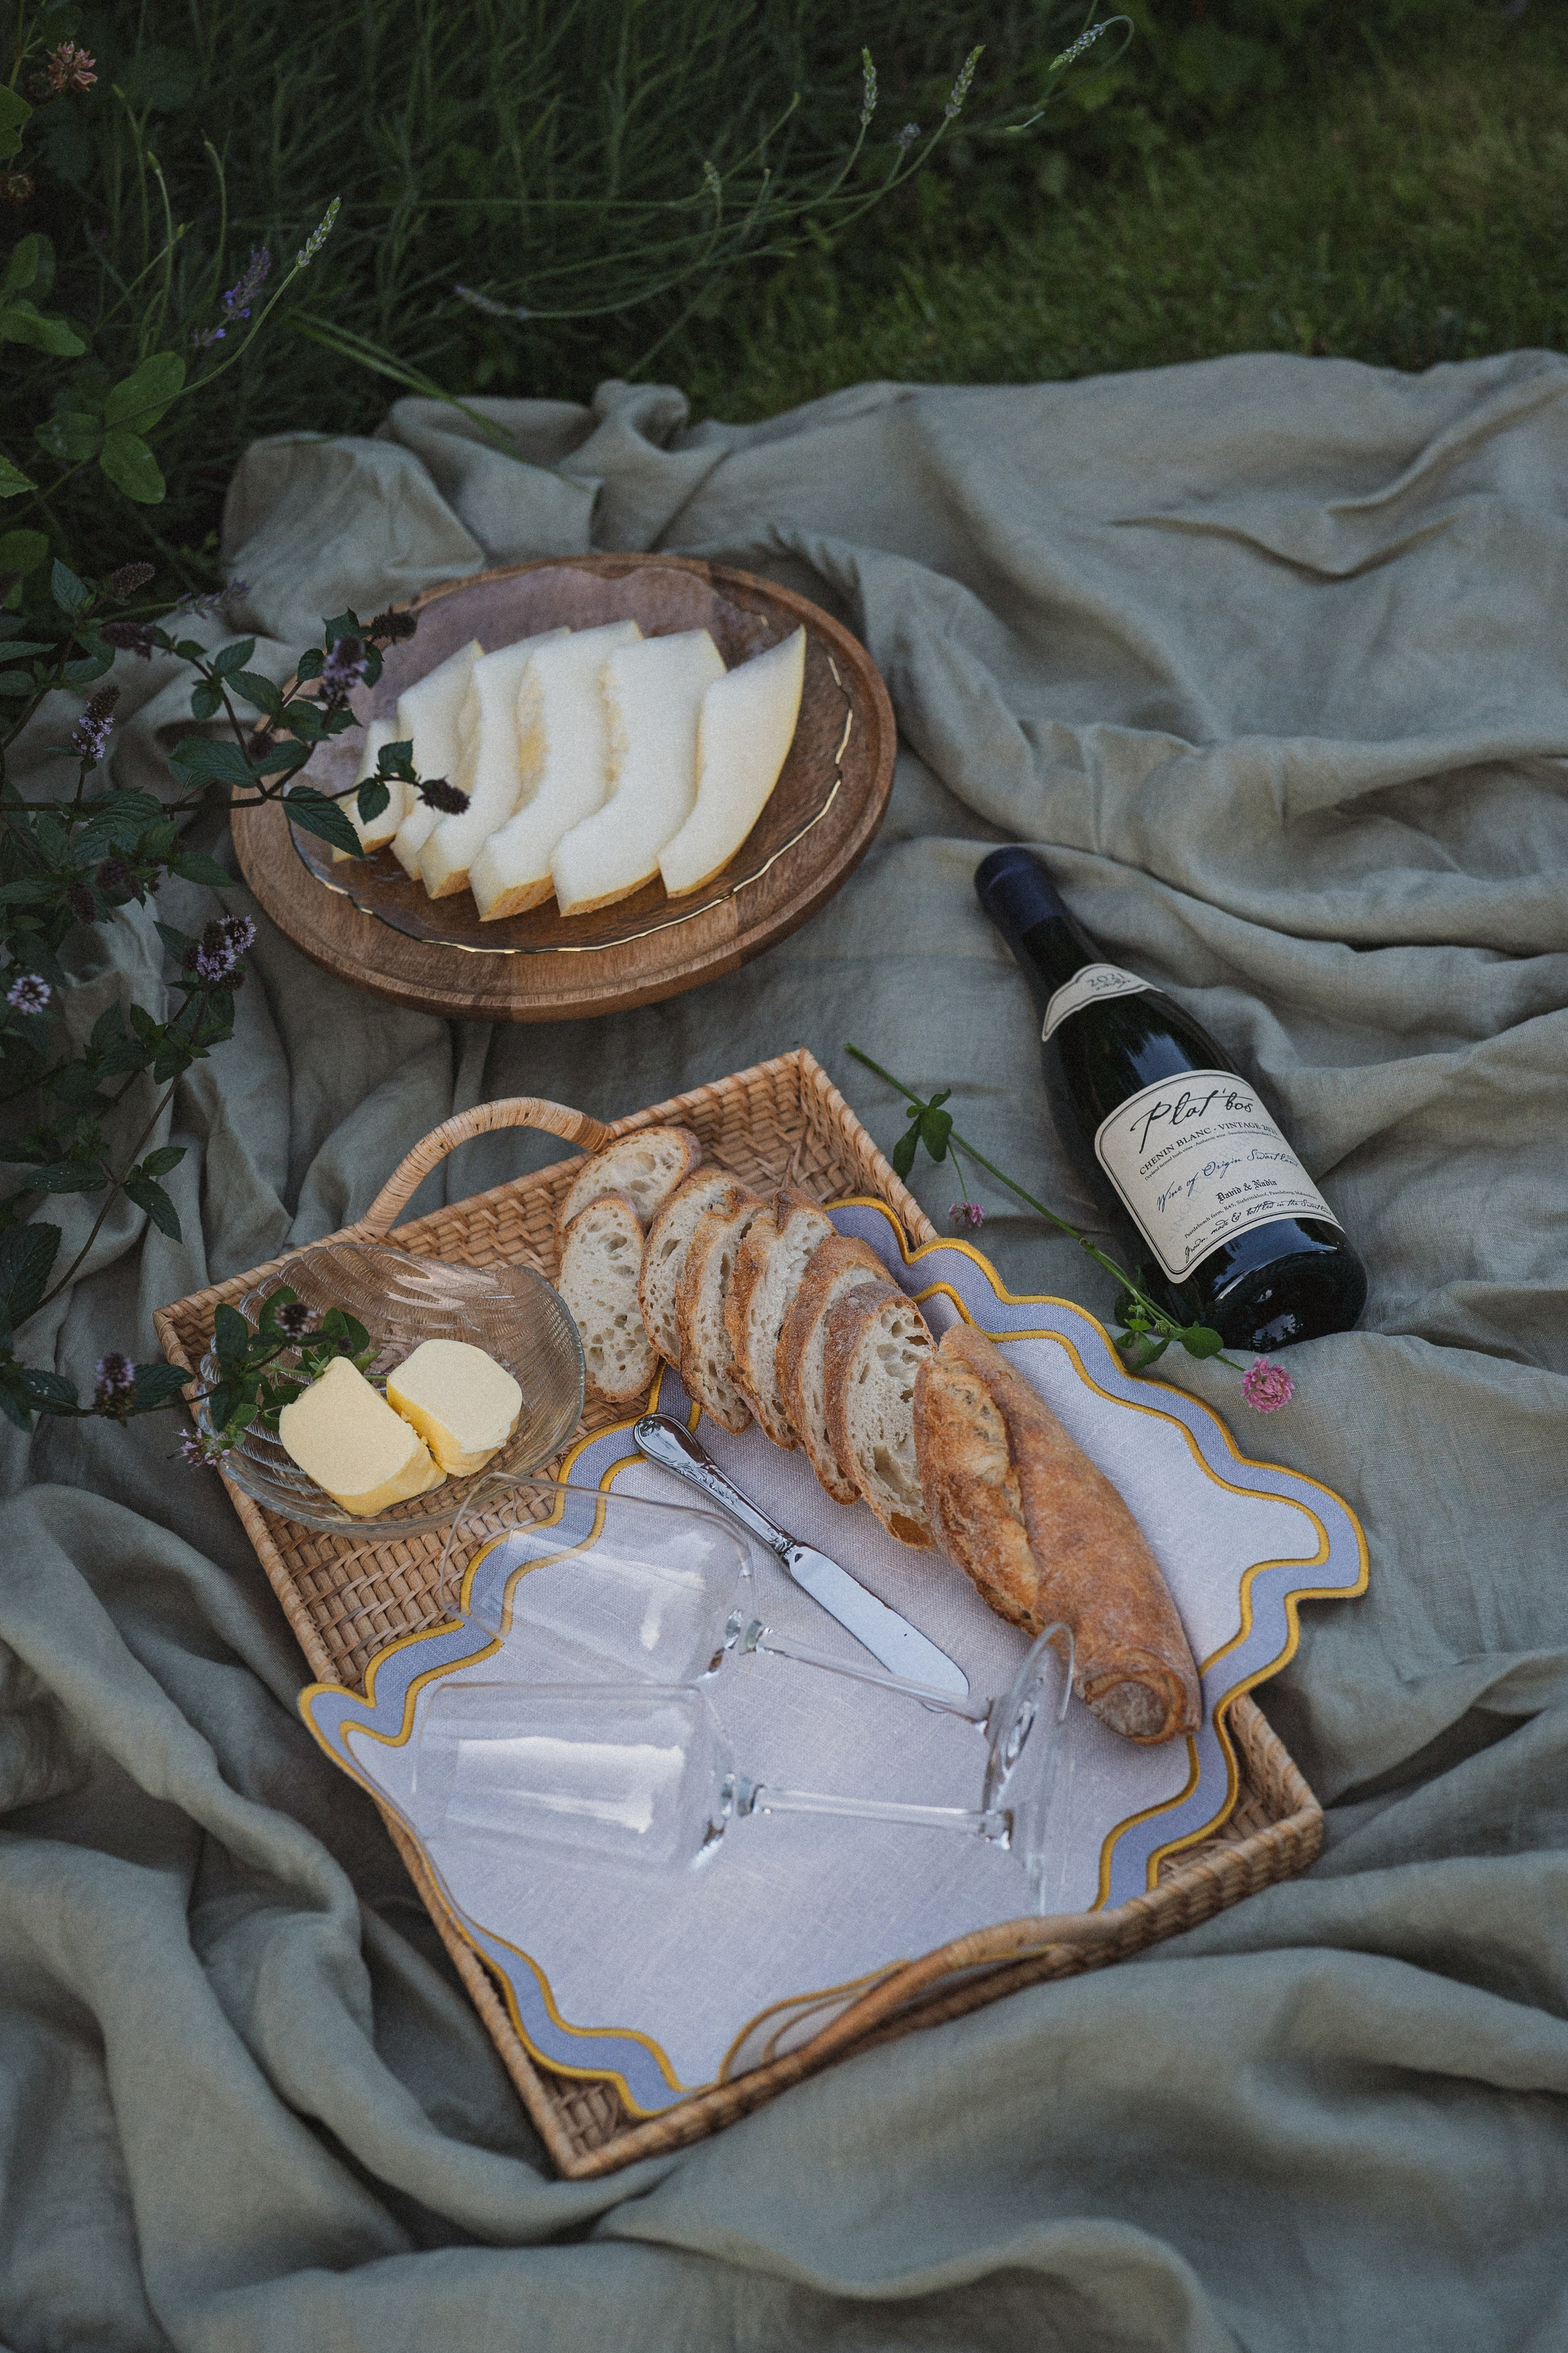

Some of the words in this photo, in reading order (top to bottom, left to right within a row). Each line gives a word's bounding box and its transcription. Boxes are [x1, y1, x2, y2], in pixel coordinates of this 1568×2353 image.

[1140, 1144, 1175, 1175] CHENIN
[1176, 1127, 1212, 1147] BLANC
[1218, 1122, 1261, 1130] VINTAGE
[1261, 1124, 1278, 1136] 2021
[1159, 1156, 1173, 1168] farmed
[1182, 1144, 1193, 1153] vines
[1196, 1136, 1215, 1146] Authentic
[1156, 1181, 1183, 1213] Wine
[1186, 1172, 1199, 1197] of
[1201, 1158, 1242, 1179] Origin
[1215, 1187, 1242, 1204] David
[1243, 1182, 1252, 1192] &
[1252, 1179, 1278, 1191] Nadia
[1184, 1217, 1211, 1239] Paardebosch
[1210, 1210, 1224, 1218] farm,
[1224, 1203, 1237, 1211] R45,
[1210, 1218, 1229, 1234] made
[1231, 1212, 1242, 1223] &
